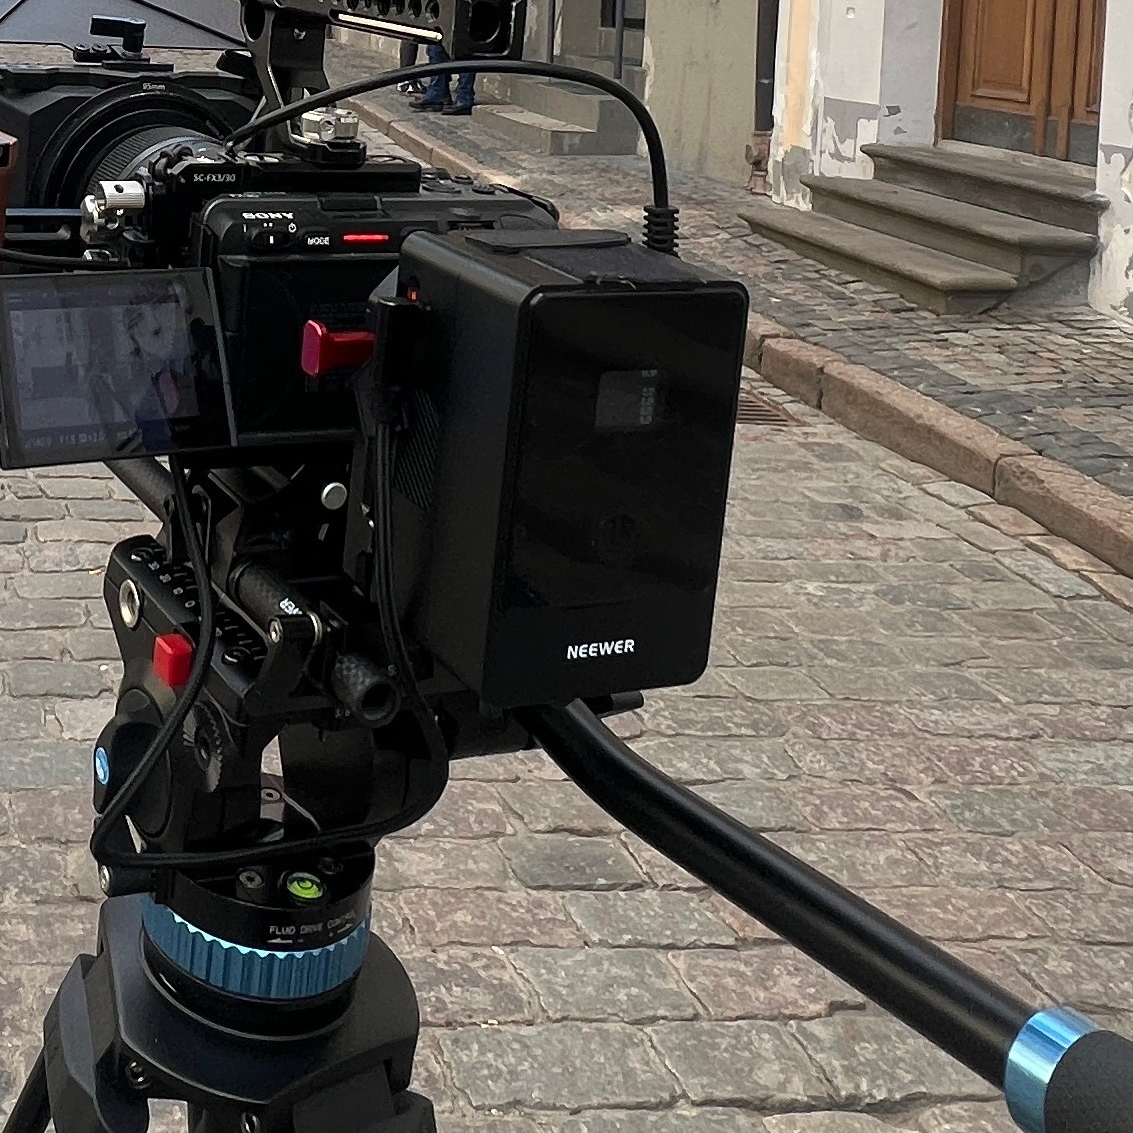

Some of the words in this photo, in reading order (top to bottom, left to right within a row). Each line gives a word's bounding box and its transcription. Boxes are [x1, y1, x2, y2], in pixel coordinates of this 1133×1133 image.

[242, 212, 294, 220] SONY
[307, 236, 330, 246] MODE
[566, 638, 635, 660] NEEWER
